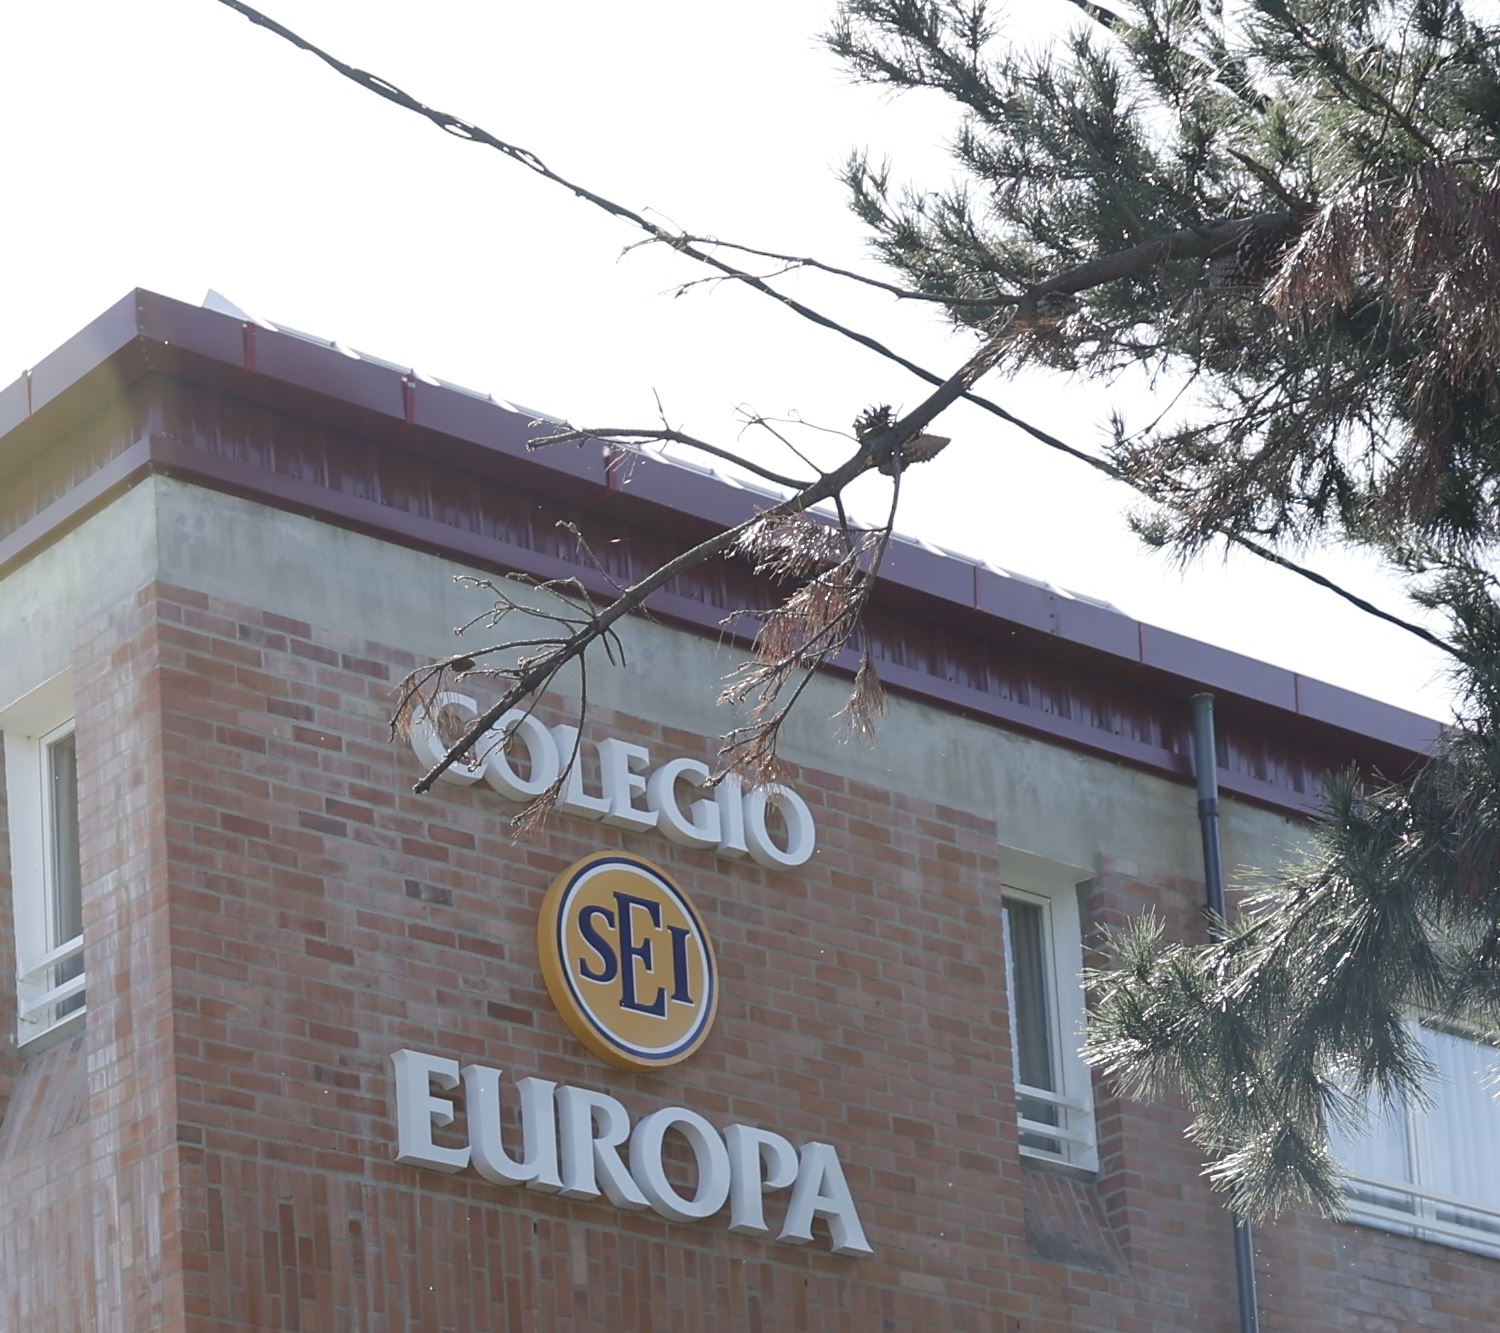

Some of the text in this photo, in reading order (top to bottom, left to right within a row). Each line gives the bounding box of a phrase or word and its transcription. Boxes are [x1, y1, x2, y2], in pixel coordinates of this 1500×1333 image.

[412, 692, 816, 867] COLEGIO
[577, 890, 695, 1018] SEI
[390, 1048, 875, 1257] EUROPA
